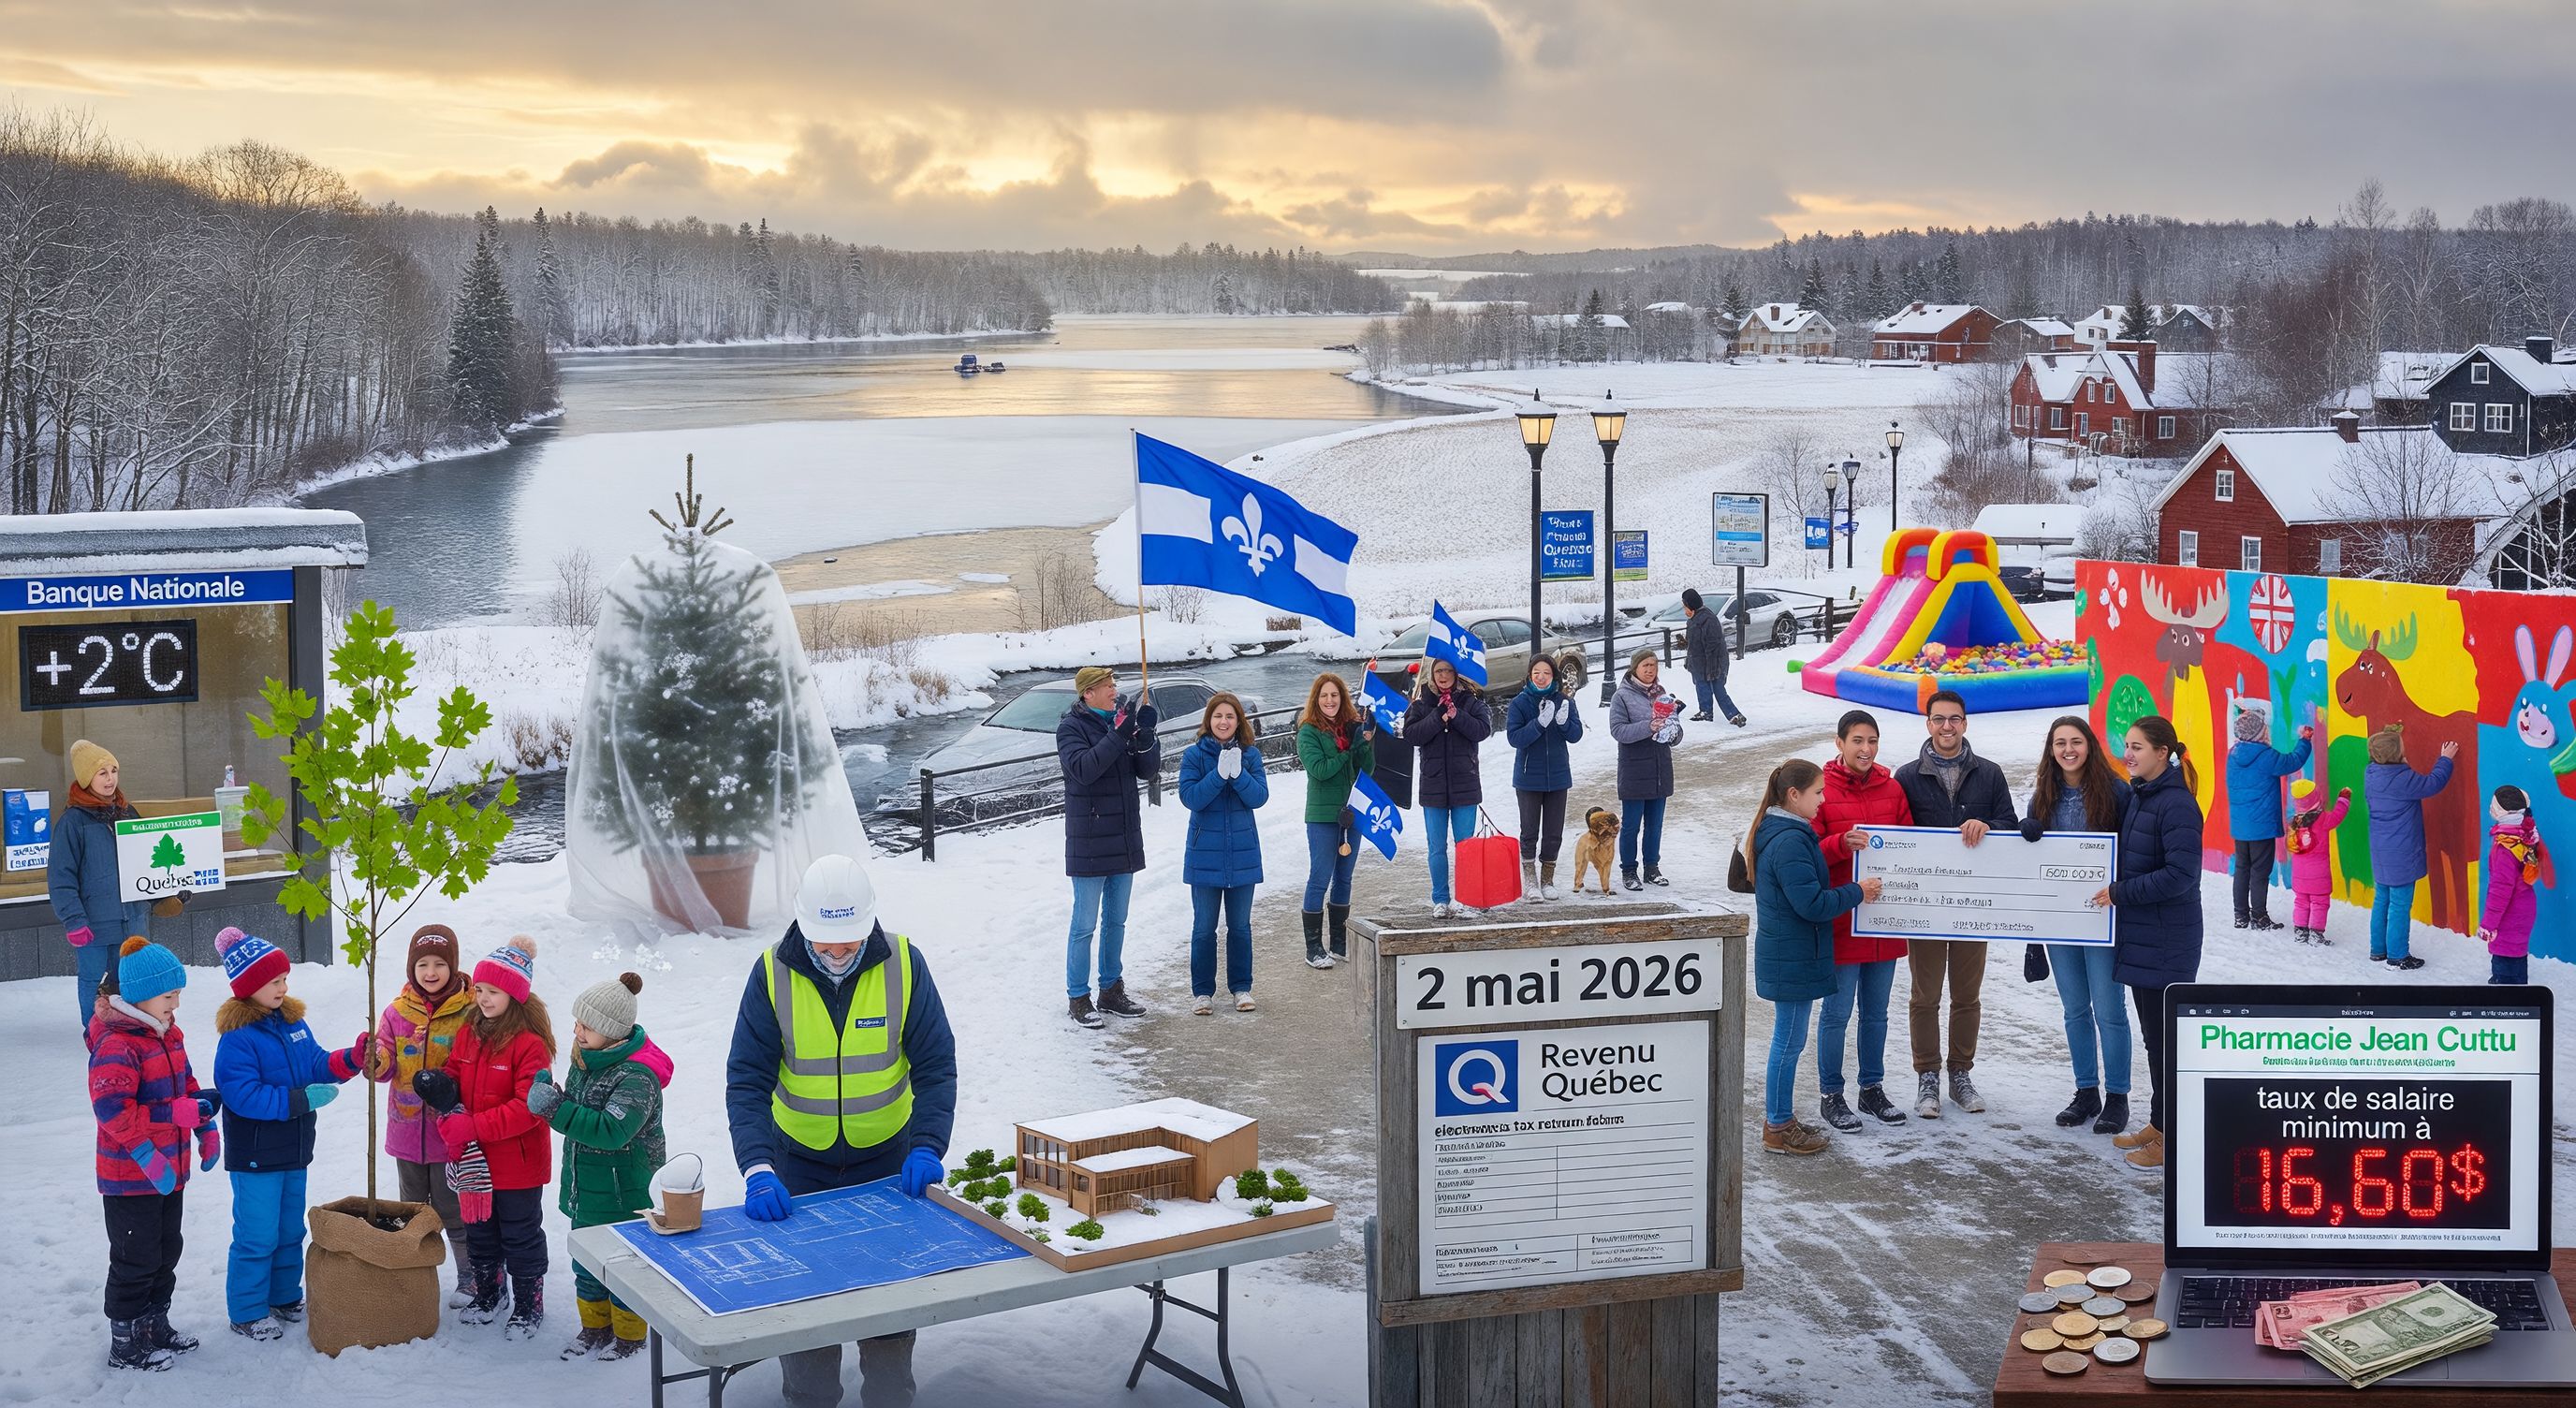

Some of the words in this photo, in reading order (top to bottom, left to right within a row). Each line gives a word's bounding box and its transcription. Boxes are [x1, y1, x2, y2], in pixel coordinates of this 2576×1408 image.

[27, 580, 124, 608] Banque
[130, 576, 244, 600] Nationale
[1416, 967, 1445, 1011] 2
[1466, 958, 1559, 1008] mai
[1579, 952, 1703, 1001] 2026
[2201, 1024, 2352, 1051] Pharmacie
[2359, 1025, 2429, 1052] Jean
[2437, 1025, 2516, 1052] Cuttu
[1542, 1043, 1655, 1068] Revenu
[1542, 1069, 1663, 1103] Québec
[2257, 1086, 2316, 1110] taux
[2323, 1085, 2358, 1110] de
[2365, 1086, 2454, 1110] salaire
[2282, 1114, 2406, 1139] minimum
[2415, 1115, 2432, 1140] à
